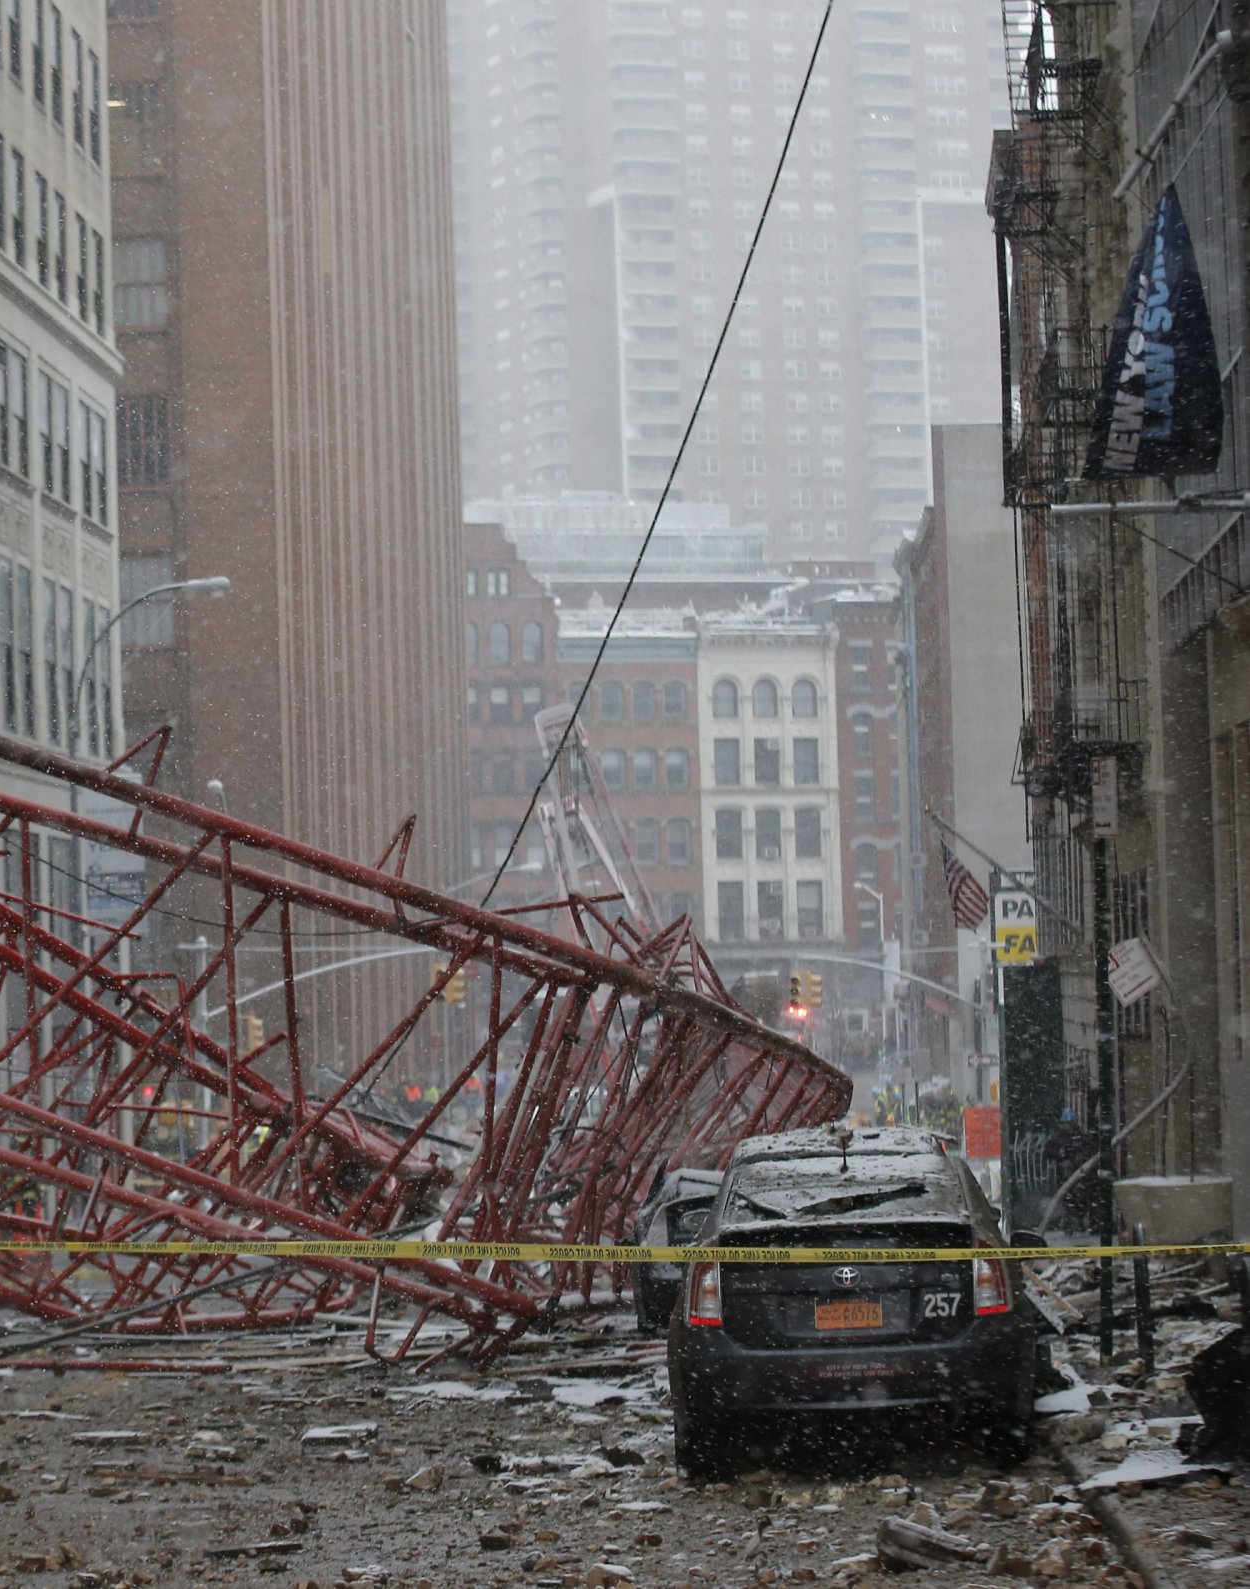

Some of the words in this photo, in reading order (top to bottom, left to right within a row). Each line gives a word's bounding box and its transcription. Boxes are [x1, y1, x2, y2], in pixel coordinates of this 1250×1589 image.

[1140, 341, 1175, 442] LAW
[1102, 389, 1145, 472] NEW
[1002, 898, 1035, 919] PA
[1004, 933, 1036, 953] FA
[924, 1293, 962, 1318] 257
